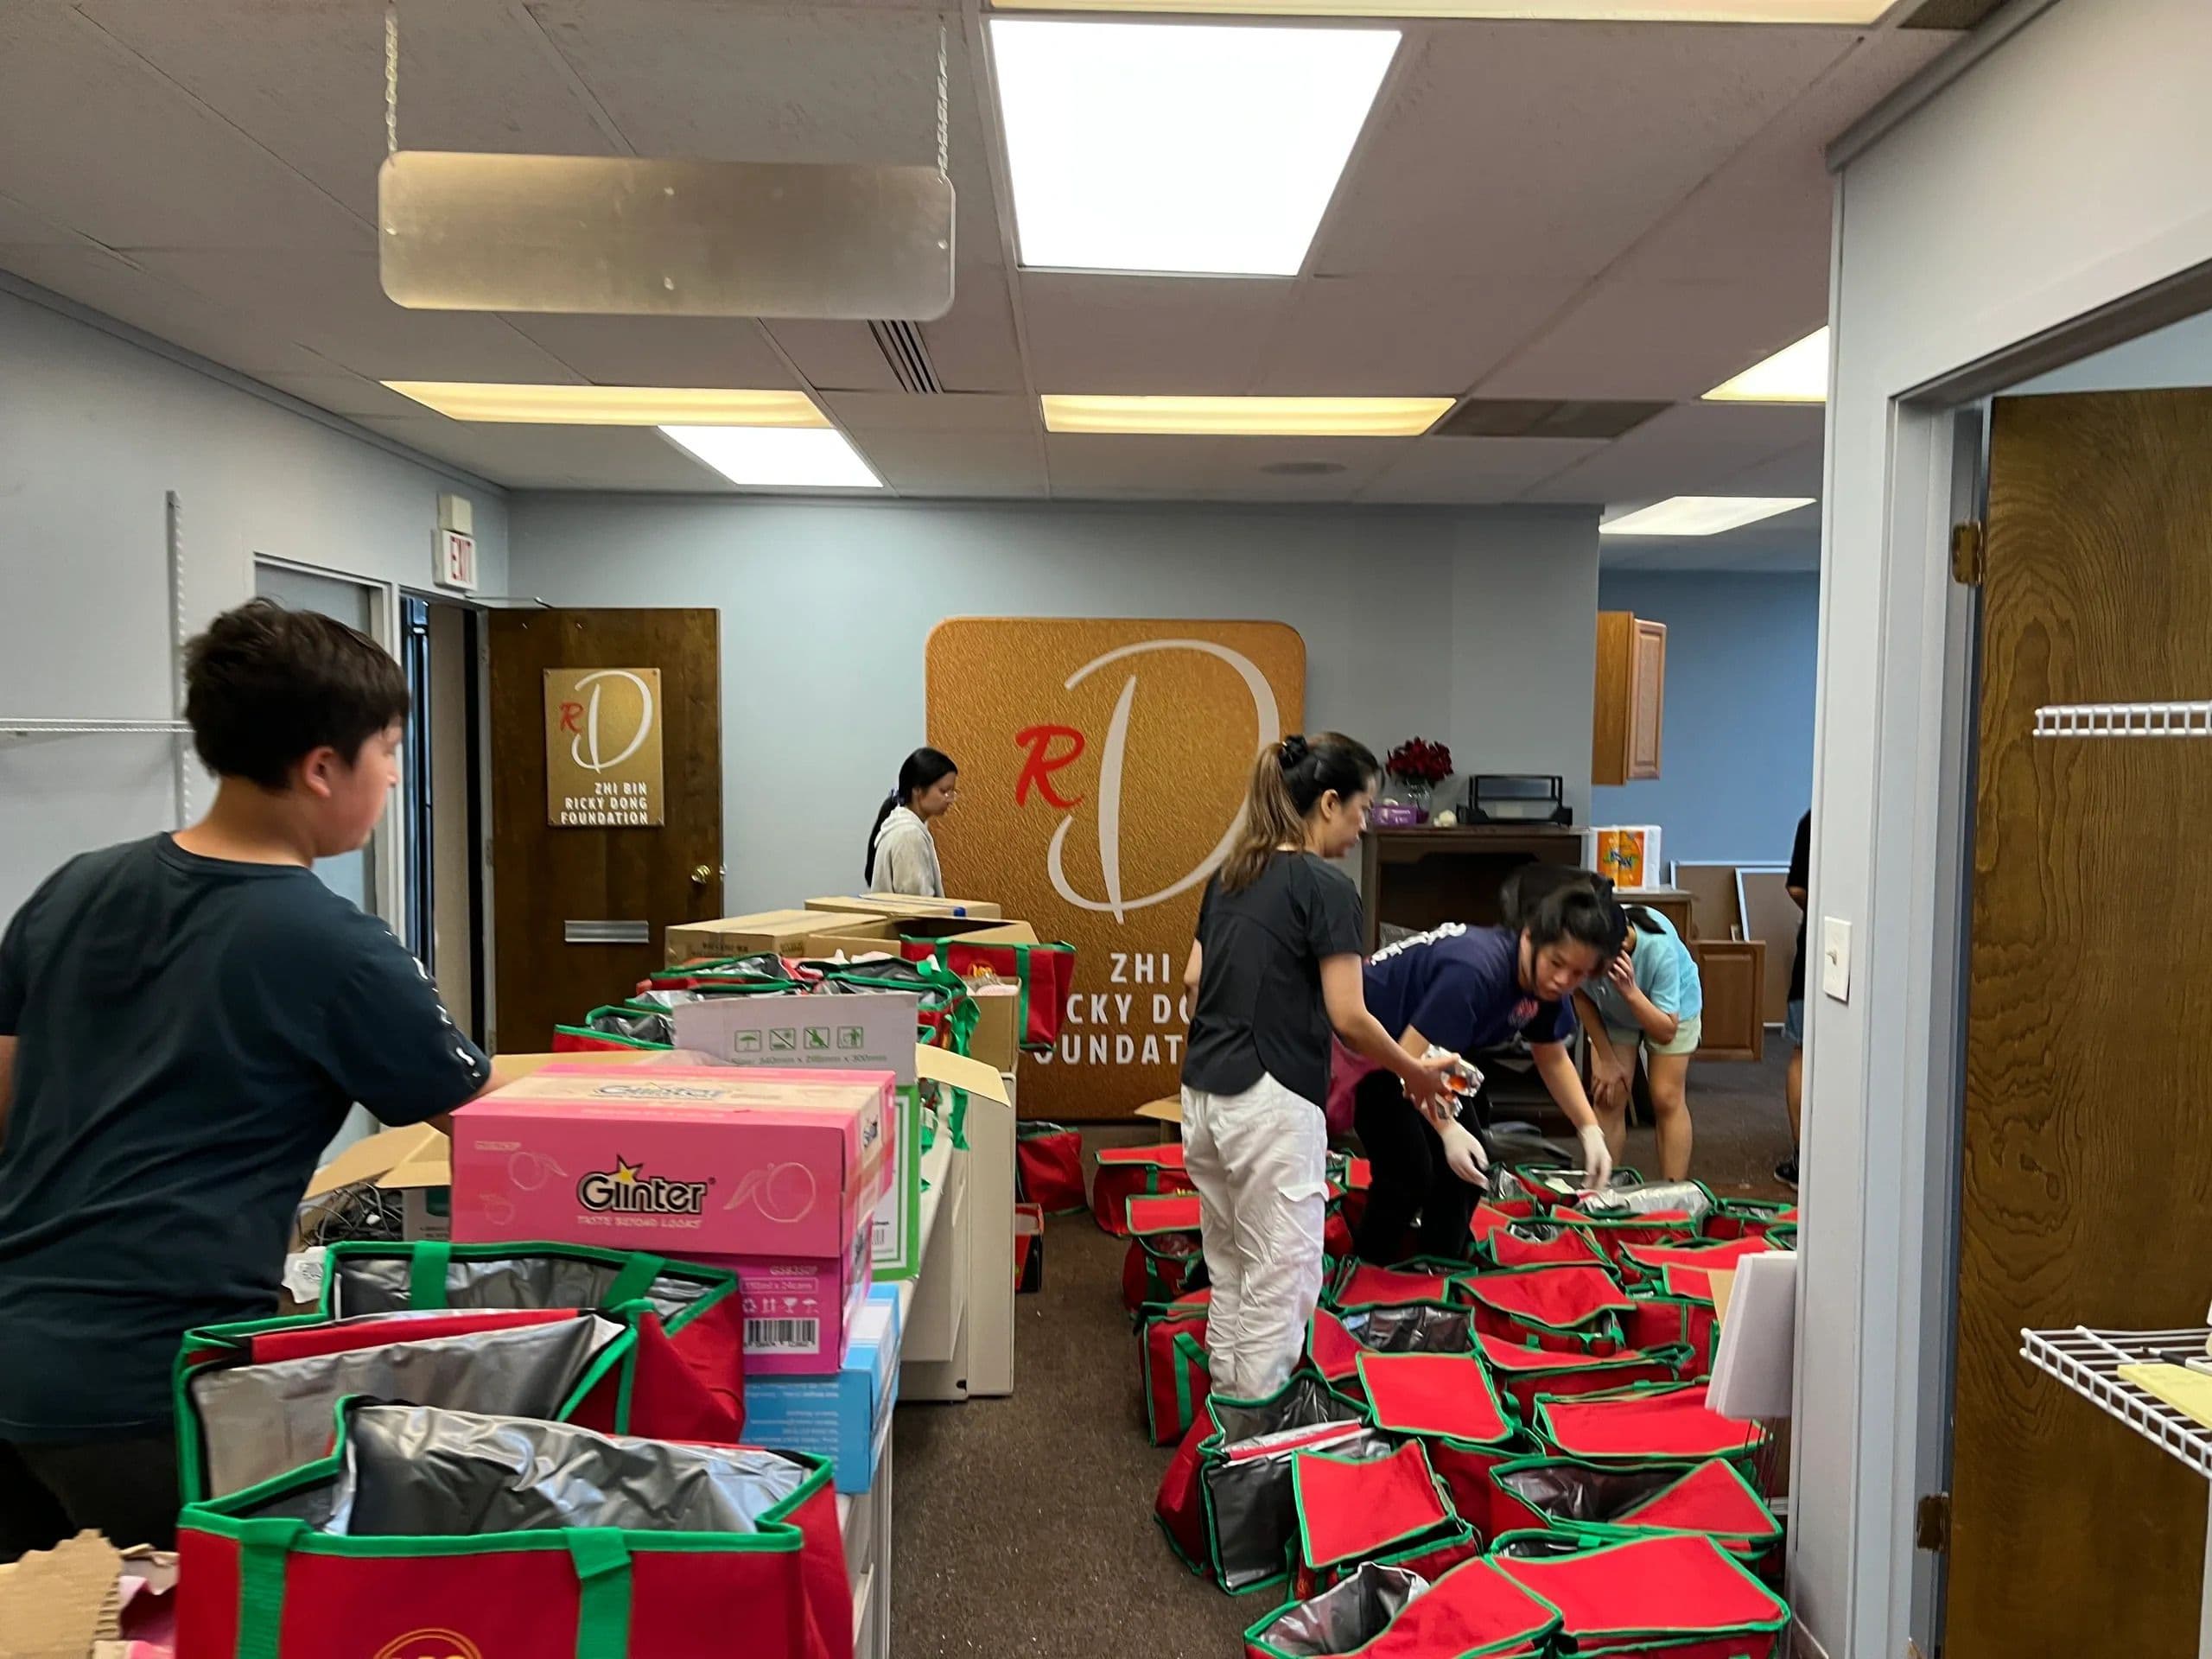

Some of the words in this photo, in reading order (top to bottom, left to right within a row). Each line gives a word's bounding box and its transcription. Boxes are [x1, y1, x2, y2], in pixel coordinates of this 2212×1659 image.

[449, 537, 472, 584] EXIT
[564, 796, 605, 810] RICKY
[610, 796, 648, 810] DONG
[594, 781, 618, 796] ZHI
[623, 781, 647, 796] BIN
[560, 811, 648, 825] FOUNDATION
[1109, 952, 1170, 983] ZHI
[1065, 993, 1133, 1025] CKY
[577, 1170, 707, 1214] Glinter
